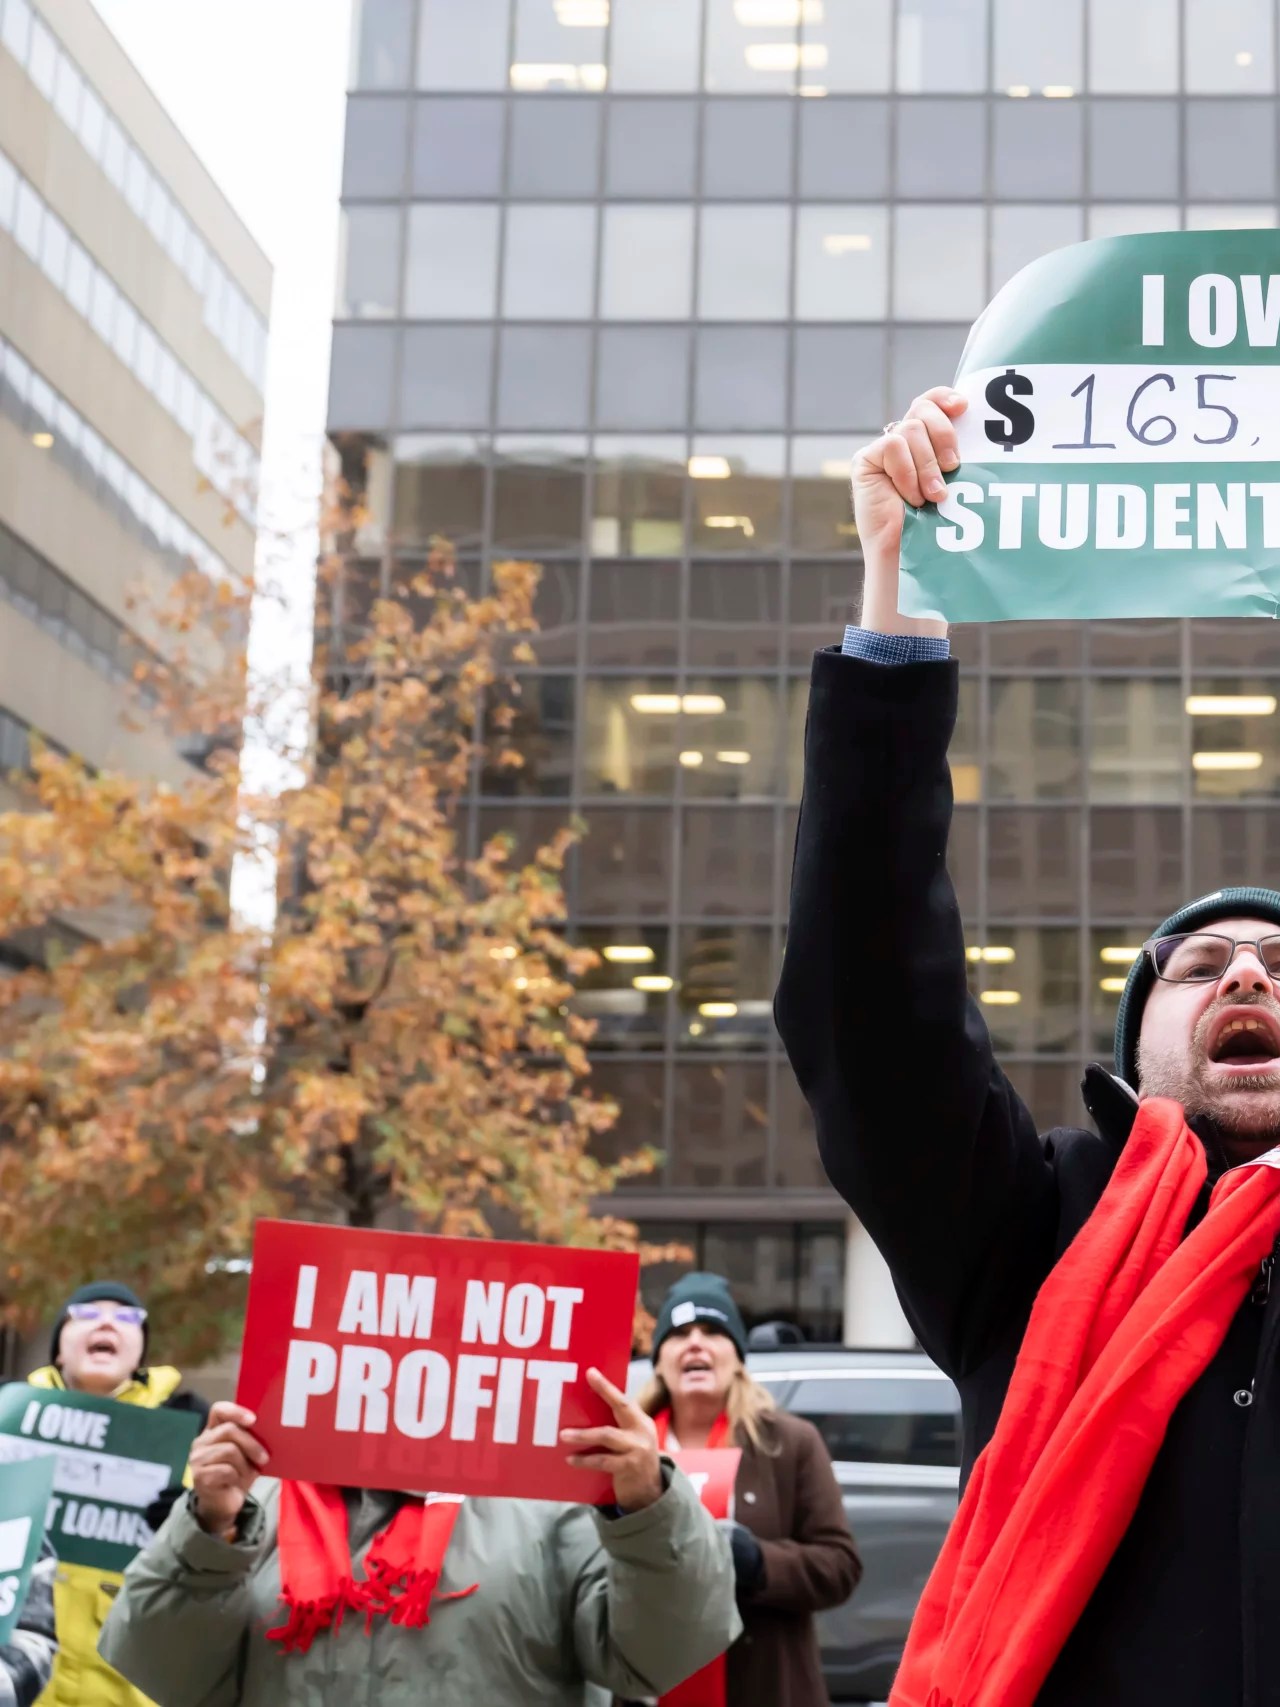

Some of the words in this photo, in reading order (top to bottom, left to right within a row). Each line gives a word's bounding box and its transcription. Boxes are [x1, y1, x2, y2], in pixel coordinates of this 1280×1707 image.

[1142, 274, 1165, 346] I
[293, 1265, 318, 1329] I
[337, 1270, 437, 1340] AM
[461, 1279, 584, 1350] NOT
[20, 1400, 42, 1435] I
[38, 1403, 111, 1448] OWE
[281, 1339, 578, 1448] PROFIT
